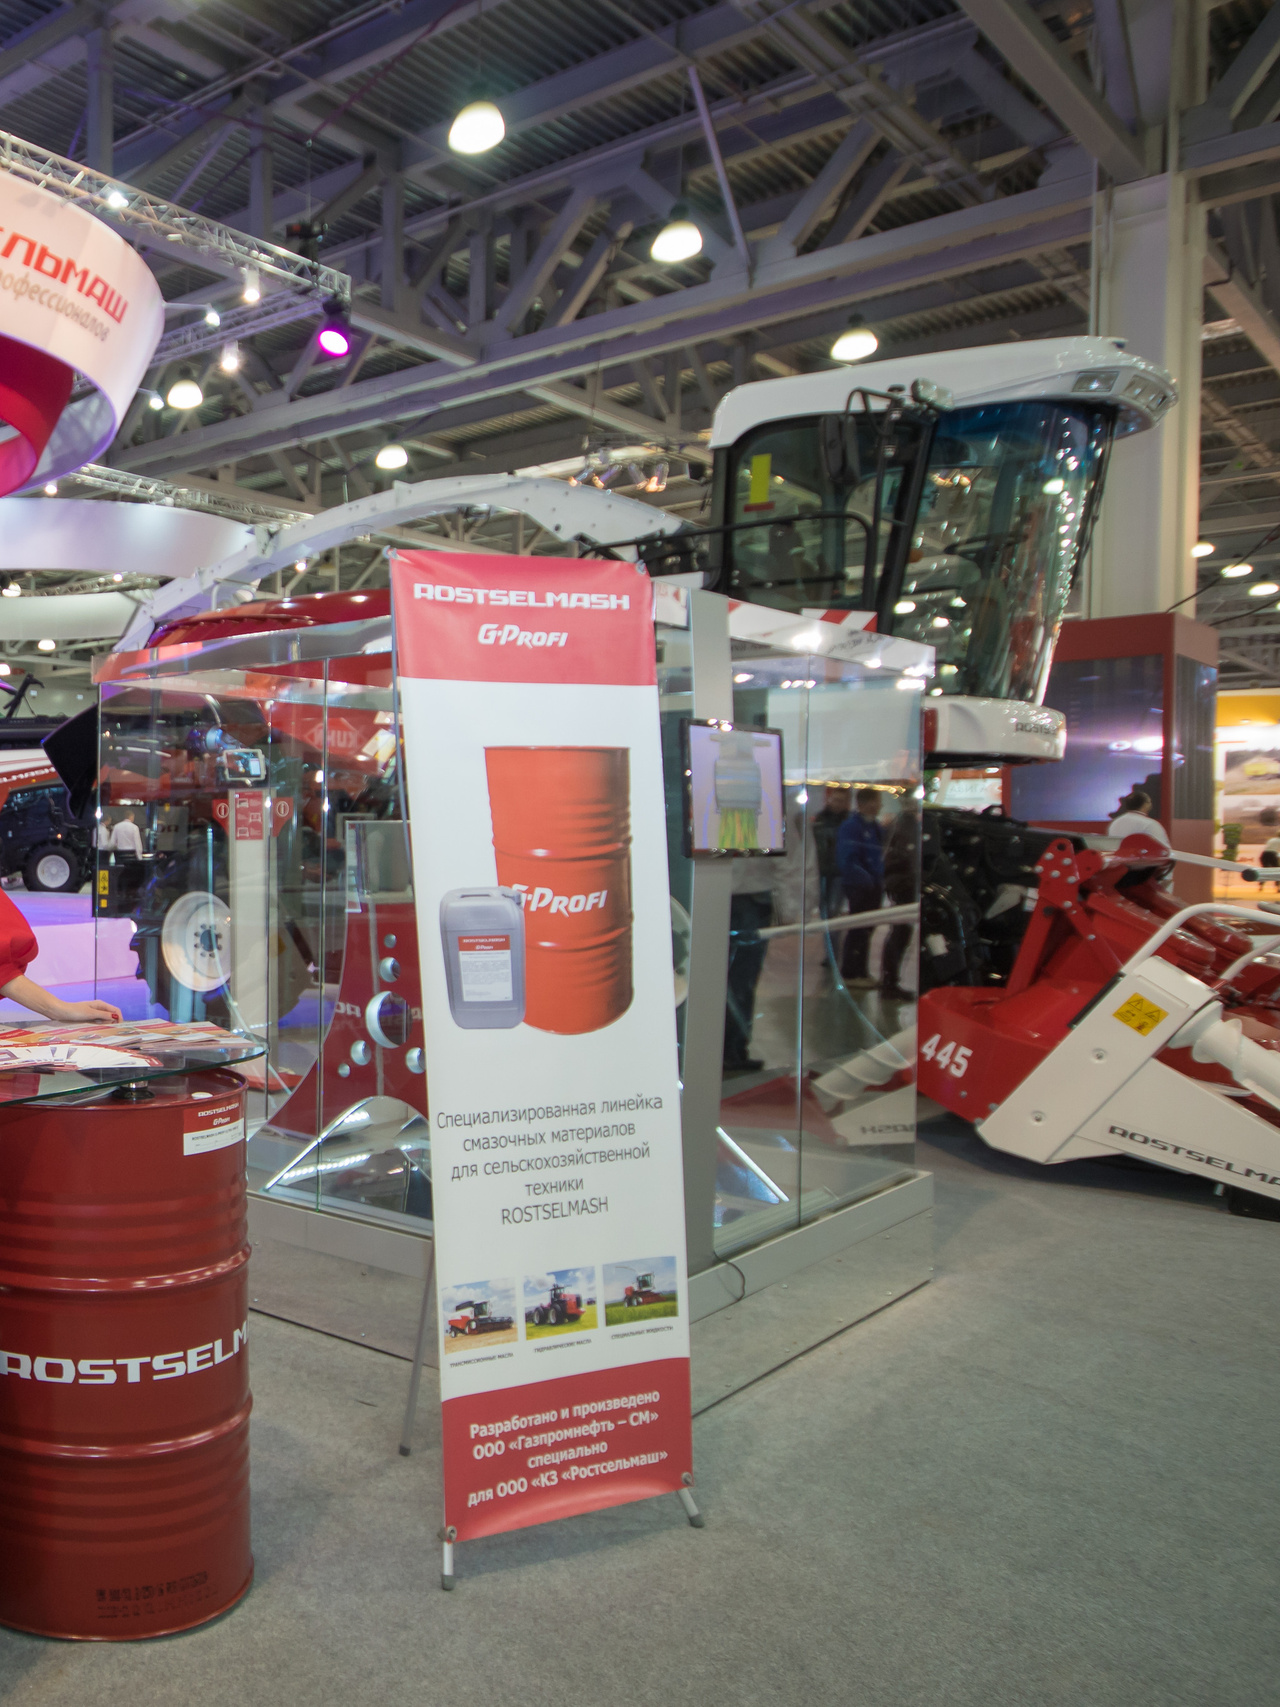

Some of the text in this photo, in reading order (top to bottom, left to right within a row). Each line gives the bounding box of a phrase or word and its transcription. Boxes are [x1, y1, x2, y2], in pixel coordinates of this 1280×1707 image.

[413, 582, 631, 610] ROSTSELMASH
[920, 1033, 973, 1078] 445
[436, 1093, 663, 1129] Специализированная линейка
[463, 1121, 636, 1152] смазочных материалов
[451, 1141, 650, 1182] для сельскохозяйственной
[524, 1177, 584, 1197] техники
[501, 1196, 609, 1225] ROSTSELMASH
[470, 1390, 660, 1439] Разработано и произведено
[472, 1440, 505, 1460] ООО
[508, 1419, 615, 1451] «Газпромнефть
[629, 1410, 659, 1427] СМ»
[527, 1441, 608, 1469] специально
[467, 1450, 668, 1508] для ООО «КЗ «Ростсельмаш»
